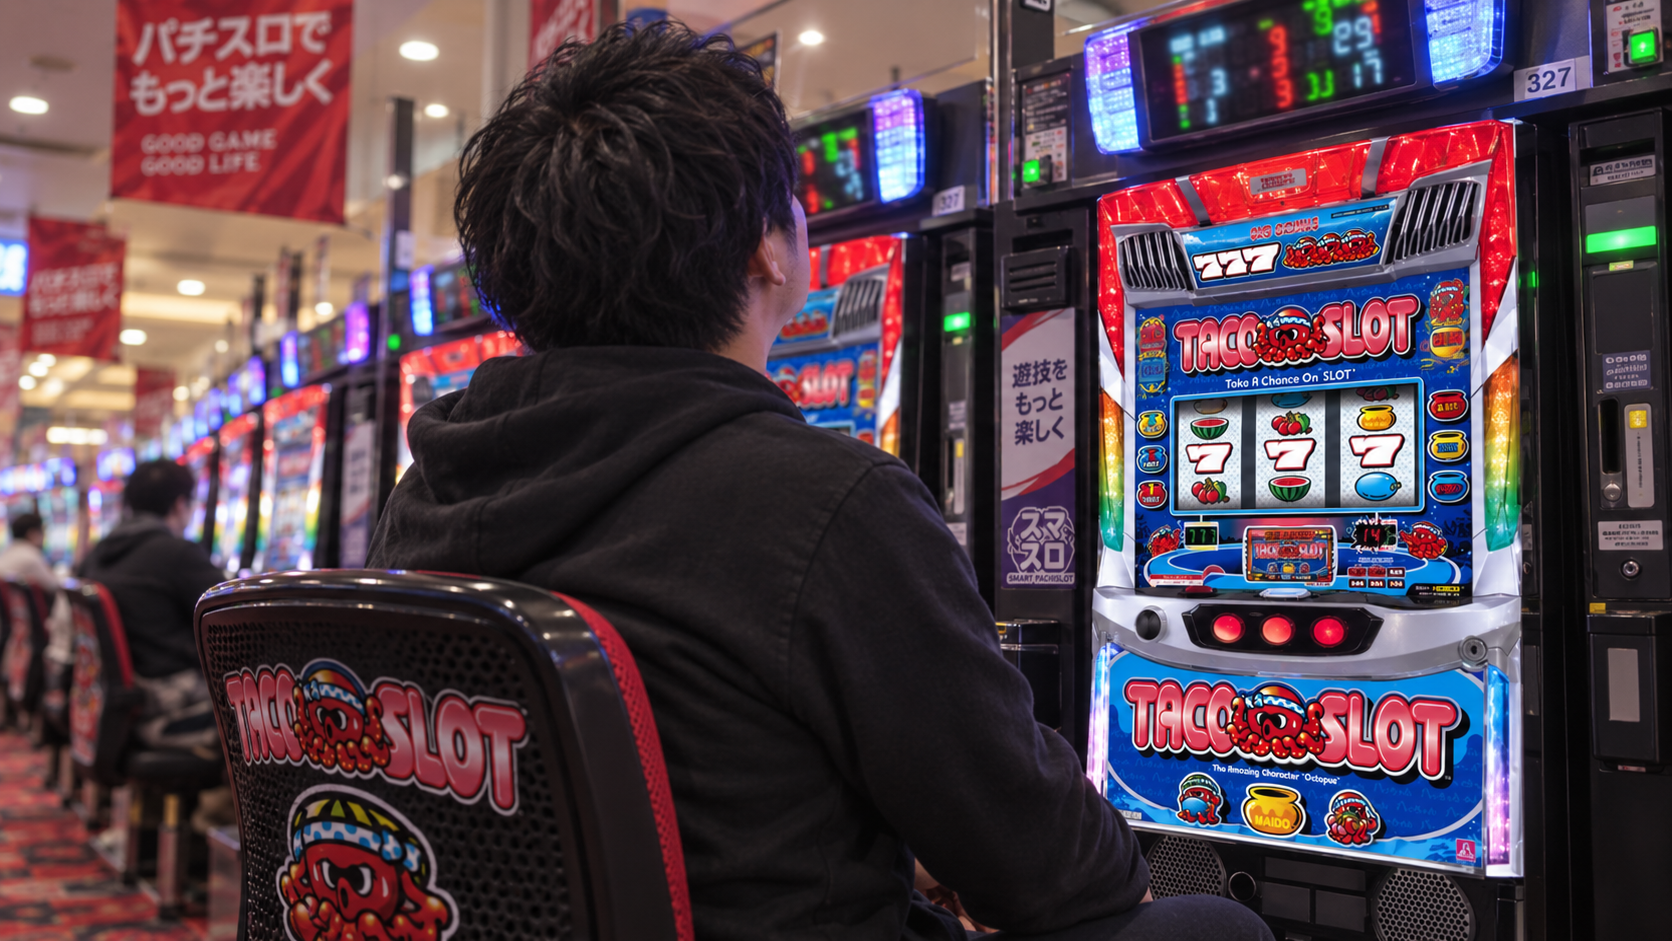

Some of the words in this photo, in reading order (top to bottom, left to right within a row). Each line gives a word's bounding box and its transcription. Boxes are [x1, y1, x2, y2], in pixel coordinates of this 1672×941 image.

[132, 11, 332, 66] パチスロで
[130, 58, 334, 116] もっと楽しく
[1527, 66, 1572, 93] 327
[141, 132, 205, 156] GOOD
[208, 127, 279, 152] GAME
[141, 154, 205, 178] GOOD
[208, 150, 261, 175] LIFE
[1192, 242, 1281, 282] 777
[1173, 310, 1259, 374] TACO
[1316, 294, 1421, 361] SLOT
[1012, 358, 1068, 388] 遊技を
[1252, 376, 1259, 387] A
[1302, 372, 1319, 383] On
[1015, 387, 1064, 415] もっと
[1014, 415, 1065, 445] 楽しく
[1186, 441, 1233, 474] 7
[1264, 438, 1316, 472] 7
[1349, 434, 1405, 469] 7
[1020, 511, 1066, 540] スマ
[1020, 542, 1065, 571] スロ
[1008, 574, 1033, 583] SMART
[223, 663, 303, 766] TACO
[370, 676, 528, 816] SLOT
[1124, 677, 1238, 757] TACO
[1316, 688, 1462, 781] SLOT
[1254, 814, 1291, 830] MAIDO
